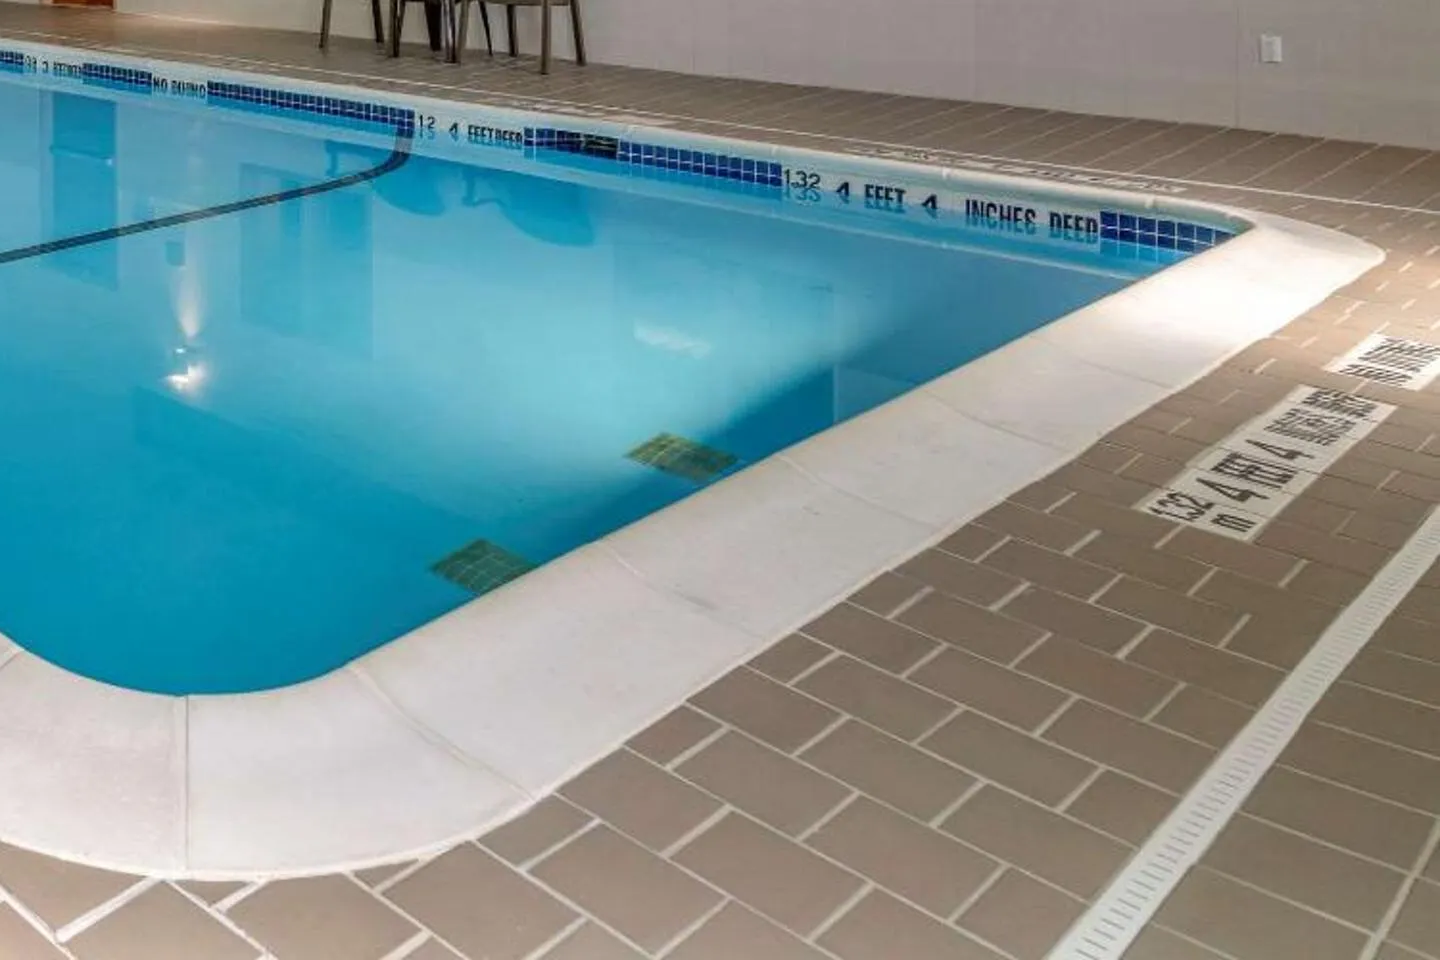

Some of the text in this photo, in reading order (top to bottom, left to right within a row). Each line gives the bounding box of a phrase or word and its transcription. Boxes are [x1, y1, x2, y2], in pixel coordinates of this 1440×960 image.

[965, 199, 1037, 225] INCHES
[1196, 477, 1270, 503] 4
[1245, 439, 1315, 460] 4
